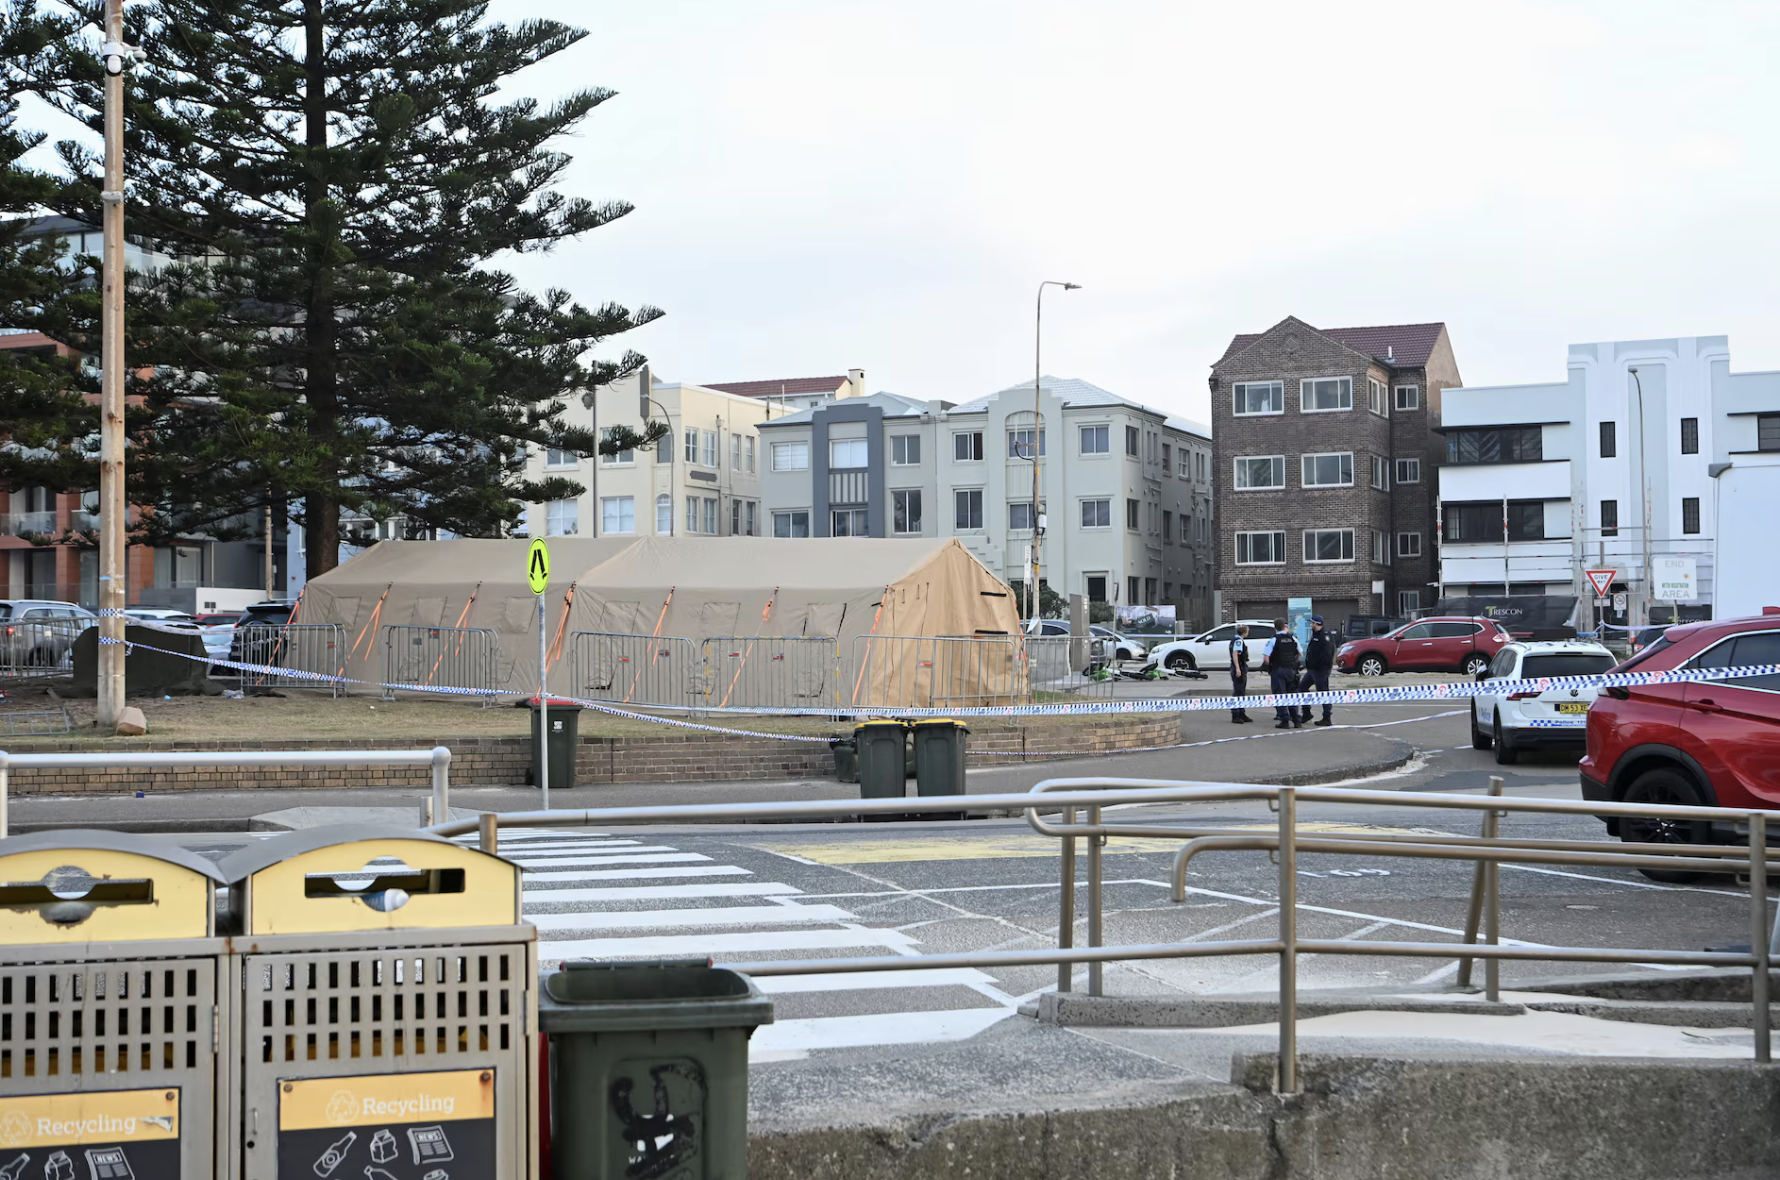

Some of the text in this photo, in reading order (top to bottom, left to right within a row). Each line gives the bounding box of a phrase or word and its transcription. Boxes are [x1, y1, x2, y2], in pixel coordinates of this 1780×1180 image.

[1664, 560, 1685, 568] END
[1661, 590, 1691, 598] AREA
[1484, 605, 1523, 617] TRESCON
[362, 1093, 455, 1117] Recycling
[36, 1114, 137, 1138] Recycling
[417, 1131, 439, 1141] NEWS
[97, 1153, 119, 1164] NEWS
